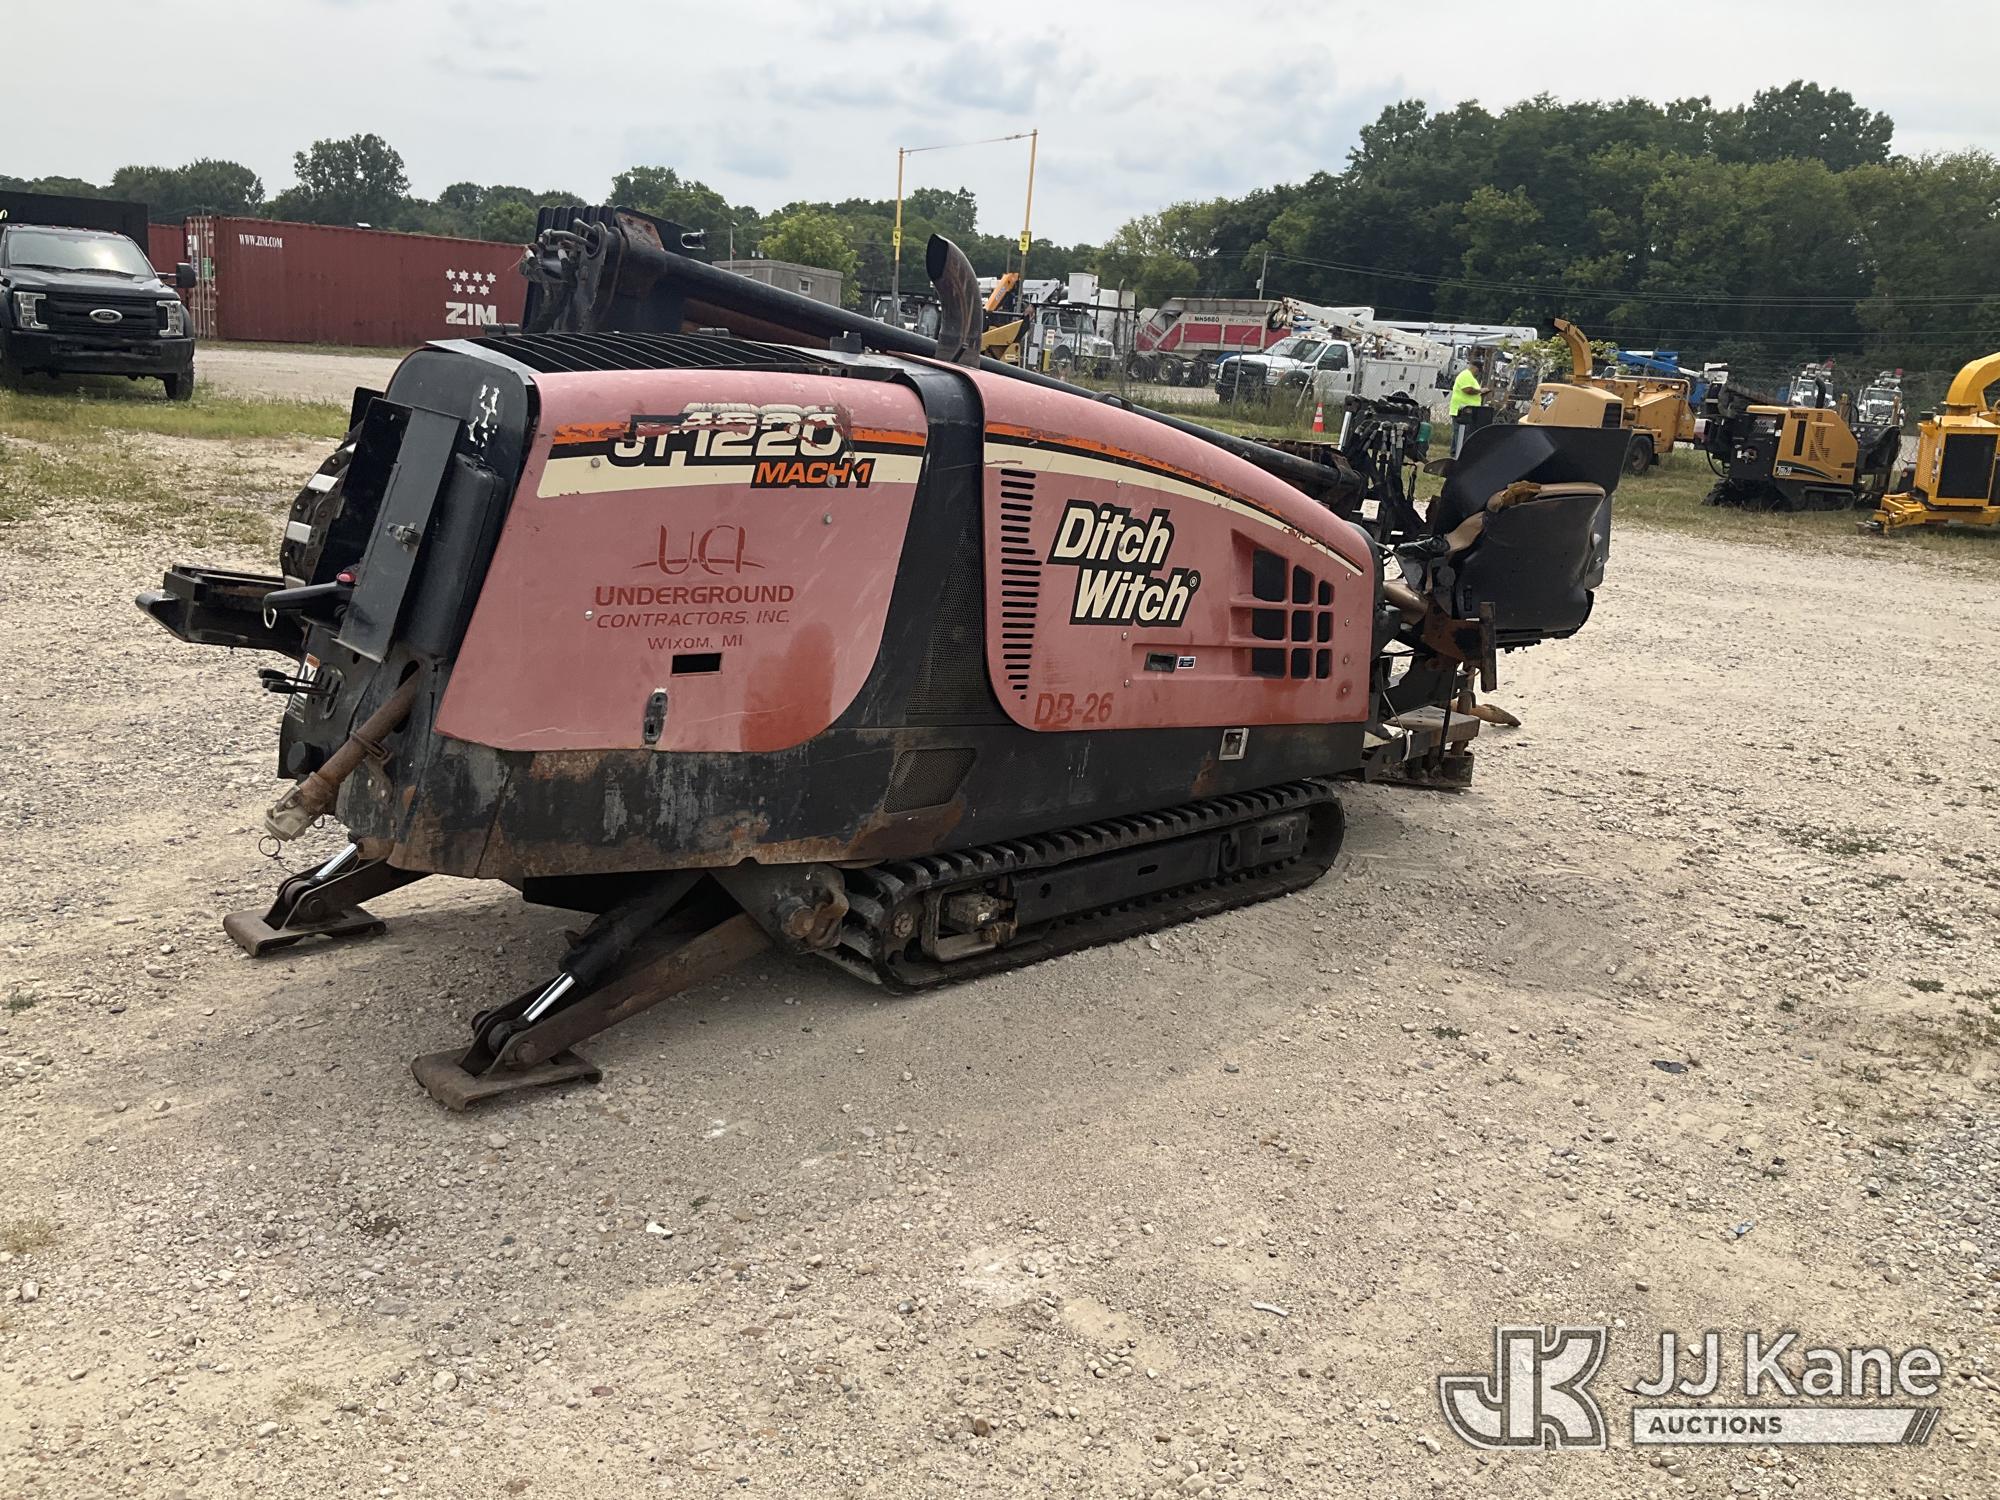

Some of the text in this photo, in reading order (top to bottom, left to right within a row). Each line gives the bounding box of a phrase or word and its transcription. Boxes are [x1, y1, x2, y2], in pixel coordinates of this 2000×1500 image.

[445, 301, 497, 326] ZIM
[755, 462, 872, 484] MACH 1
[1053, 507, 1170, 564] Ditch
[657, 524, 746, 576] UCI
[594, 585, 795, 606] UNDERGROUND
[756, 610, 790, 624] INC.
[722, 635, 743, 647] MI
[1034, 692, 1114, 725] DB-26
